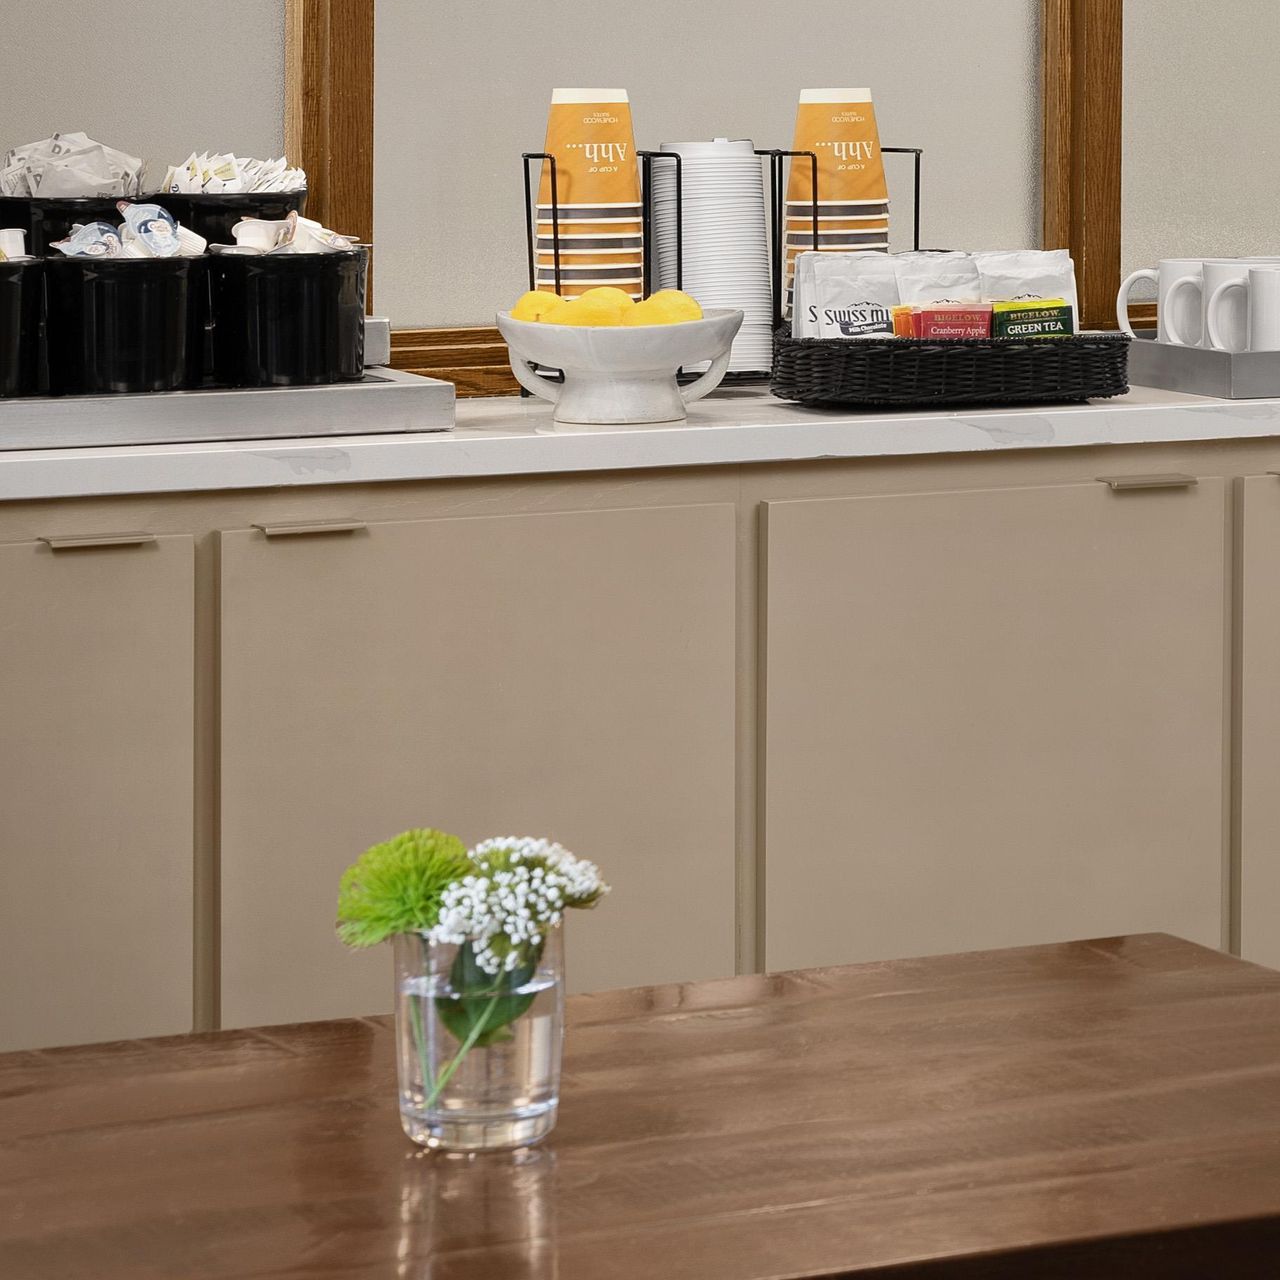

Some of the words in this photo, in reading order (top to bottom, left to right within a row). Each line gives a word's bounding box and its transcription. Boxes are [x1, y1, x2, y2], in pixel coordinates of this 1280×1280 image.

[565, 143, 627, 162] Ahh...
[815, 141, 874, 161] Ahh...
[1010, 309, 1060, 321] BIGELOW
[930, 326, 966, 336] Cranberry
[966, 326, 986, 336] Apple
[1007, 322, 1042, 335] GREEN
[1043, 321, 1064, 331] TEA
